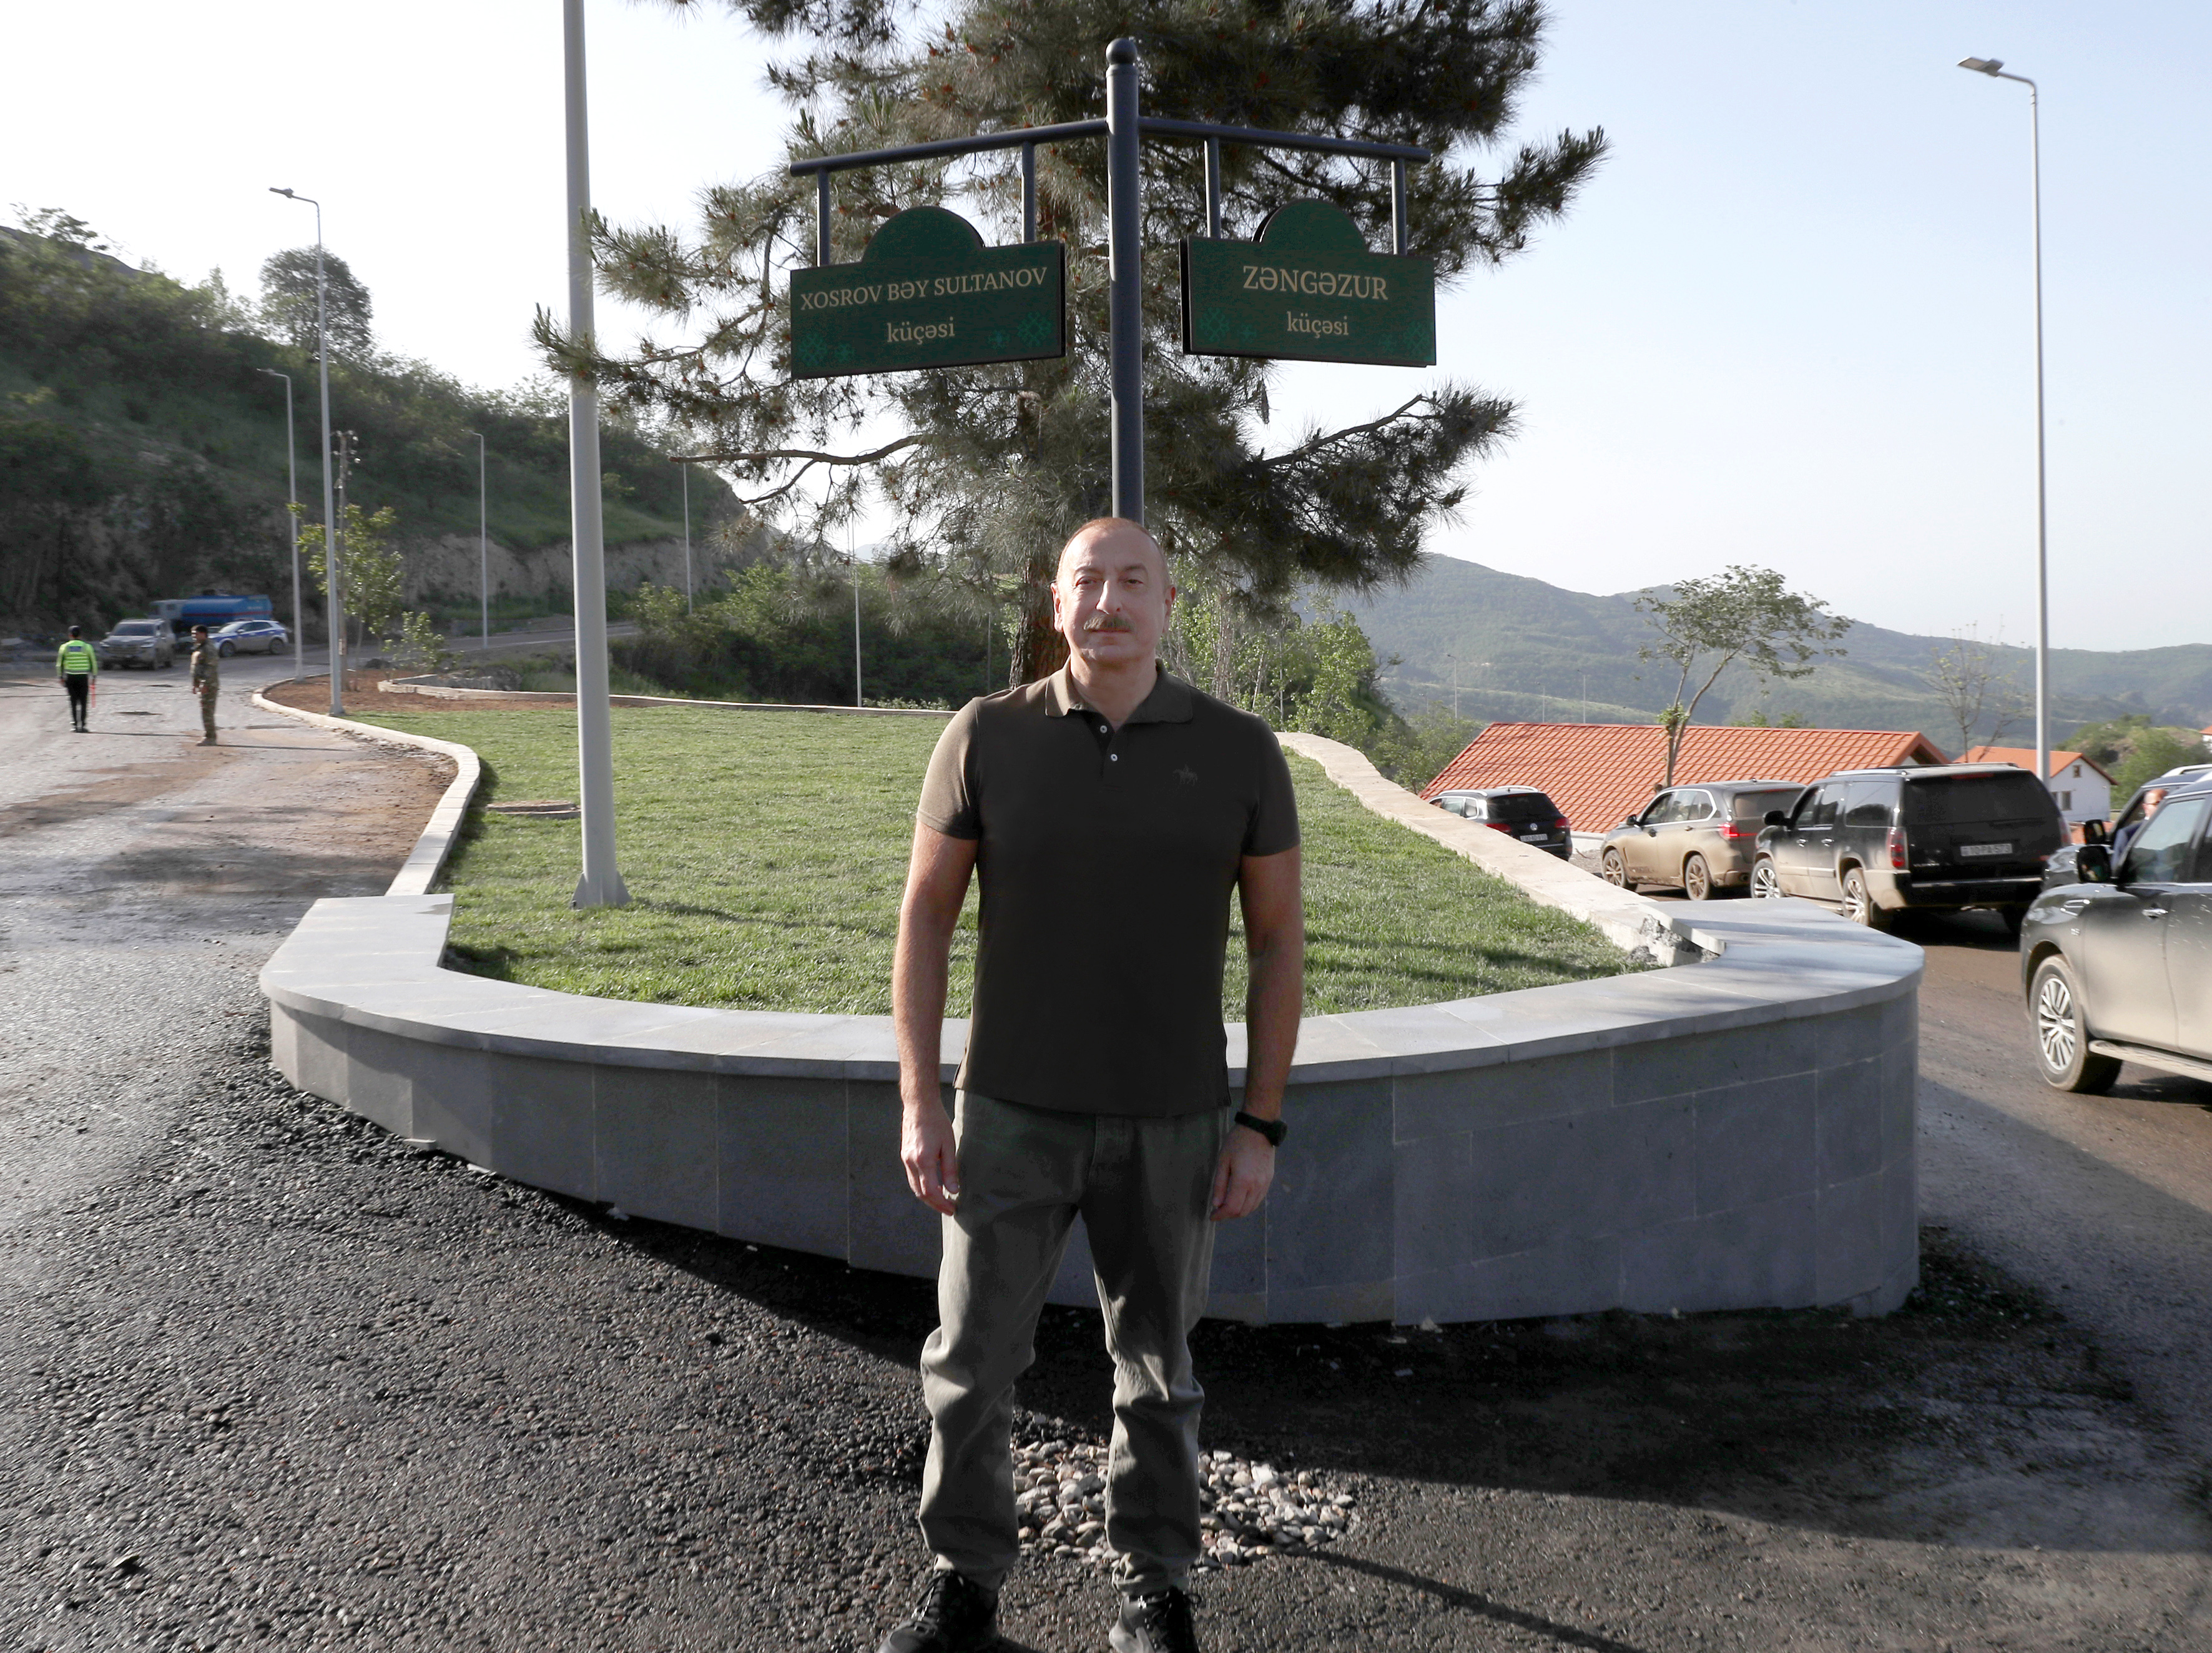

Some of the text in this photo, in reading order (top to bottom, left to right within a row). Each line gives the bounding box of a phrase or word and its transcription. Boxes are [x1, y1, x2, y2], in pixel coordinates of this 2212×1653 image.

[800, 266, 1048, 311] XOSROV BƏY SULTANOV
[1243, 265, 1389, 300] ZƏNGƏZUR
[887, 316, 956, 345] küçəsi
[1287, 310, 1350, 338] küçəsi
